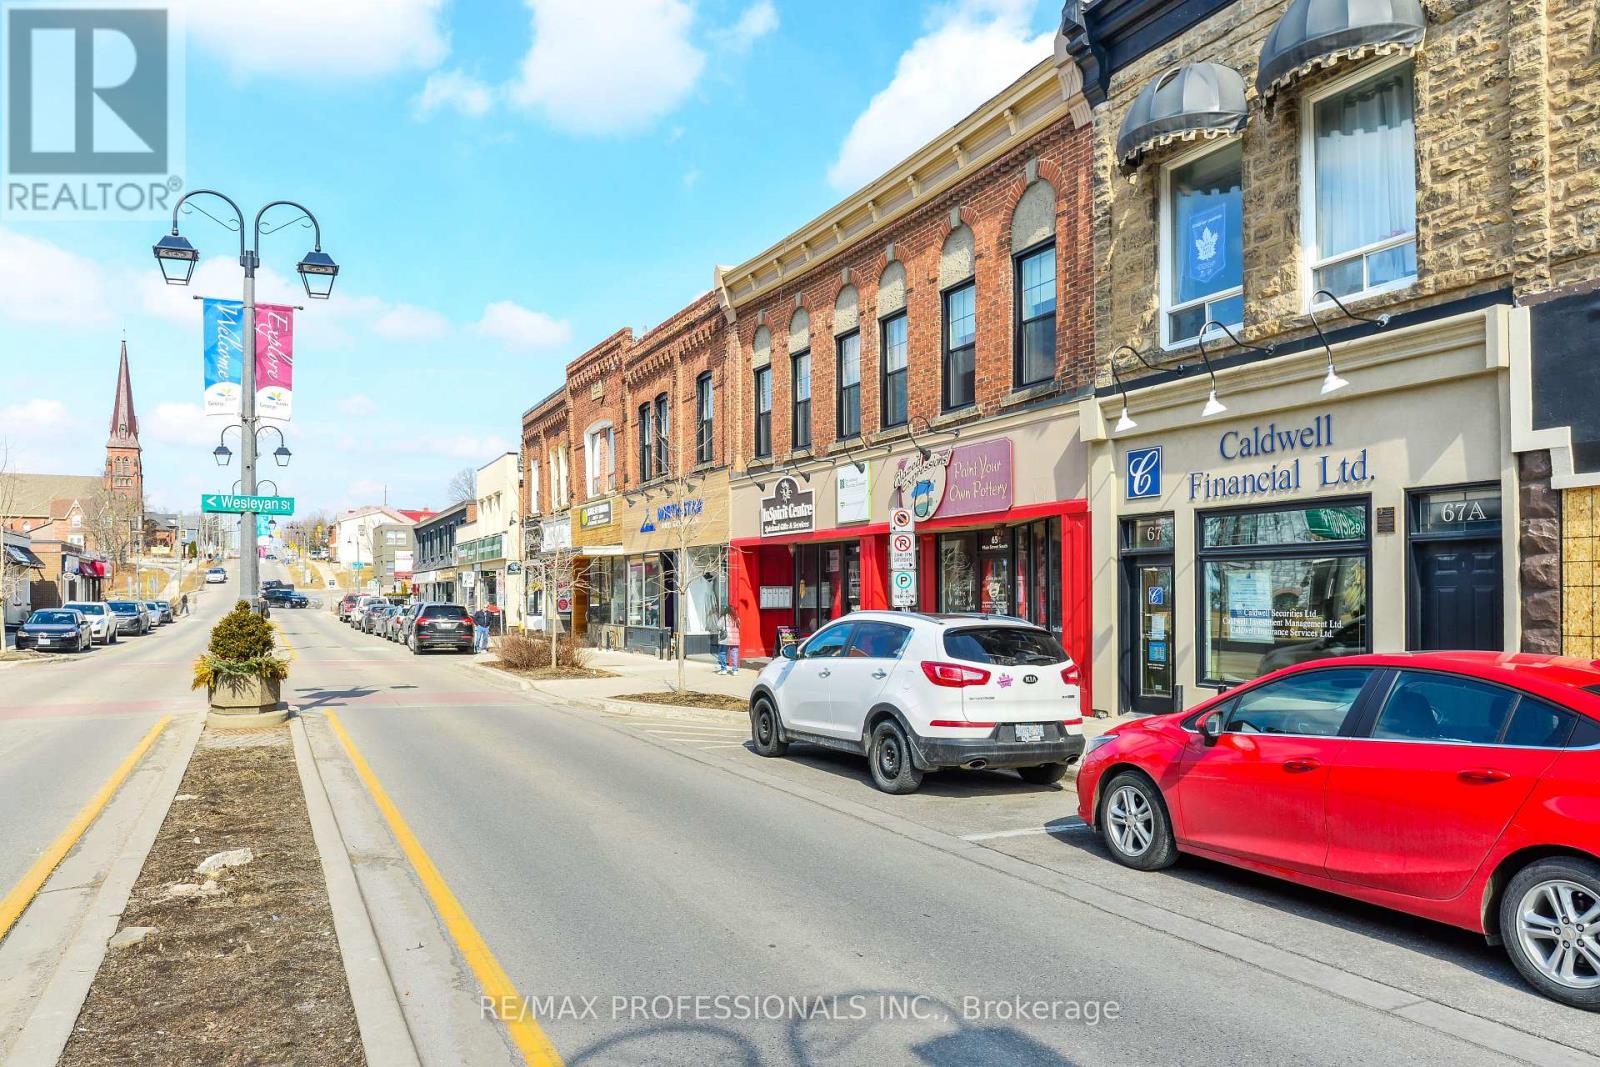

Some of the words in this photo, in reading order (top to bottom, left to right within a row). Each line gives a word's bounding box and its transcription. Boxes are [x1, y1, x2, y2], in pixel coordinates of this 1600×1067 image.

[216, 304, 243, 379] Welcome
[255, 312, 293, 380] Explore
[1219, 412, 1334, 461] Caldwell
[954, 463, 978, 479] Paint
[978, 455, 1001, 479] Your
[1189, 458, 1301, 501] Financial
[1319, 448, 1376, 486] Ltd.
[949, 482, 971, 501] Own
[973, 480, 1008, 500] Pottery
[221, 495, 279, 512] Wesleyan
[280, 500, 290, 511] St
[763, 505, 788, 525] InSpirit
[789, 503, 813, 518] Centre
[1440, 501, 1487, 522] 67A
[991, 535, 999, 544] 65
[1147, 526, 1162, 541] 67
[1243, 608, 1269, 617] Caldwell
[1271, 608, 1303, 618] Securities
[1304, 609, 1319, 618] Ltd.
[1259, 627, 1288, 636] Insurance
[1289, 628, 1318, 638] Services
[1320, 629, 1334, 638] Ltd.
[1284, 619, 1327, 629] Management
[1329, 619, 1344, 629] Ltd.
[1025, 675, 1037, 683] KIA
